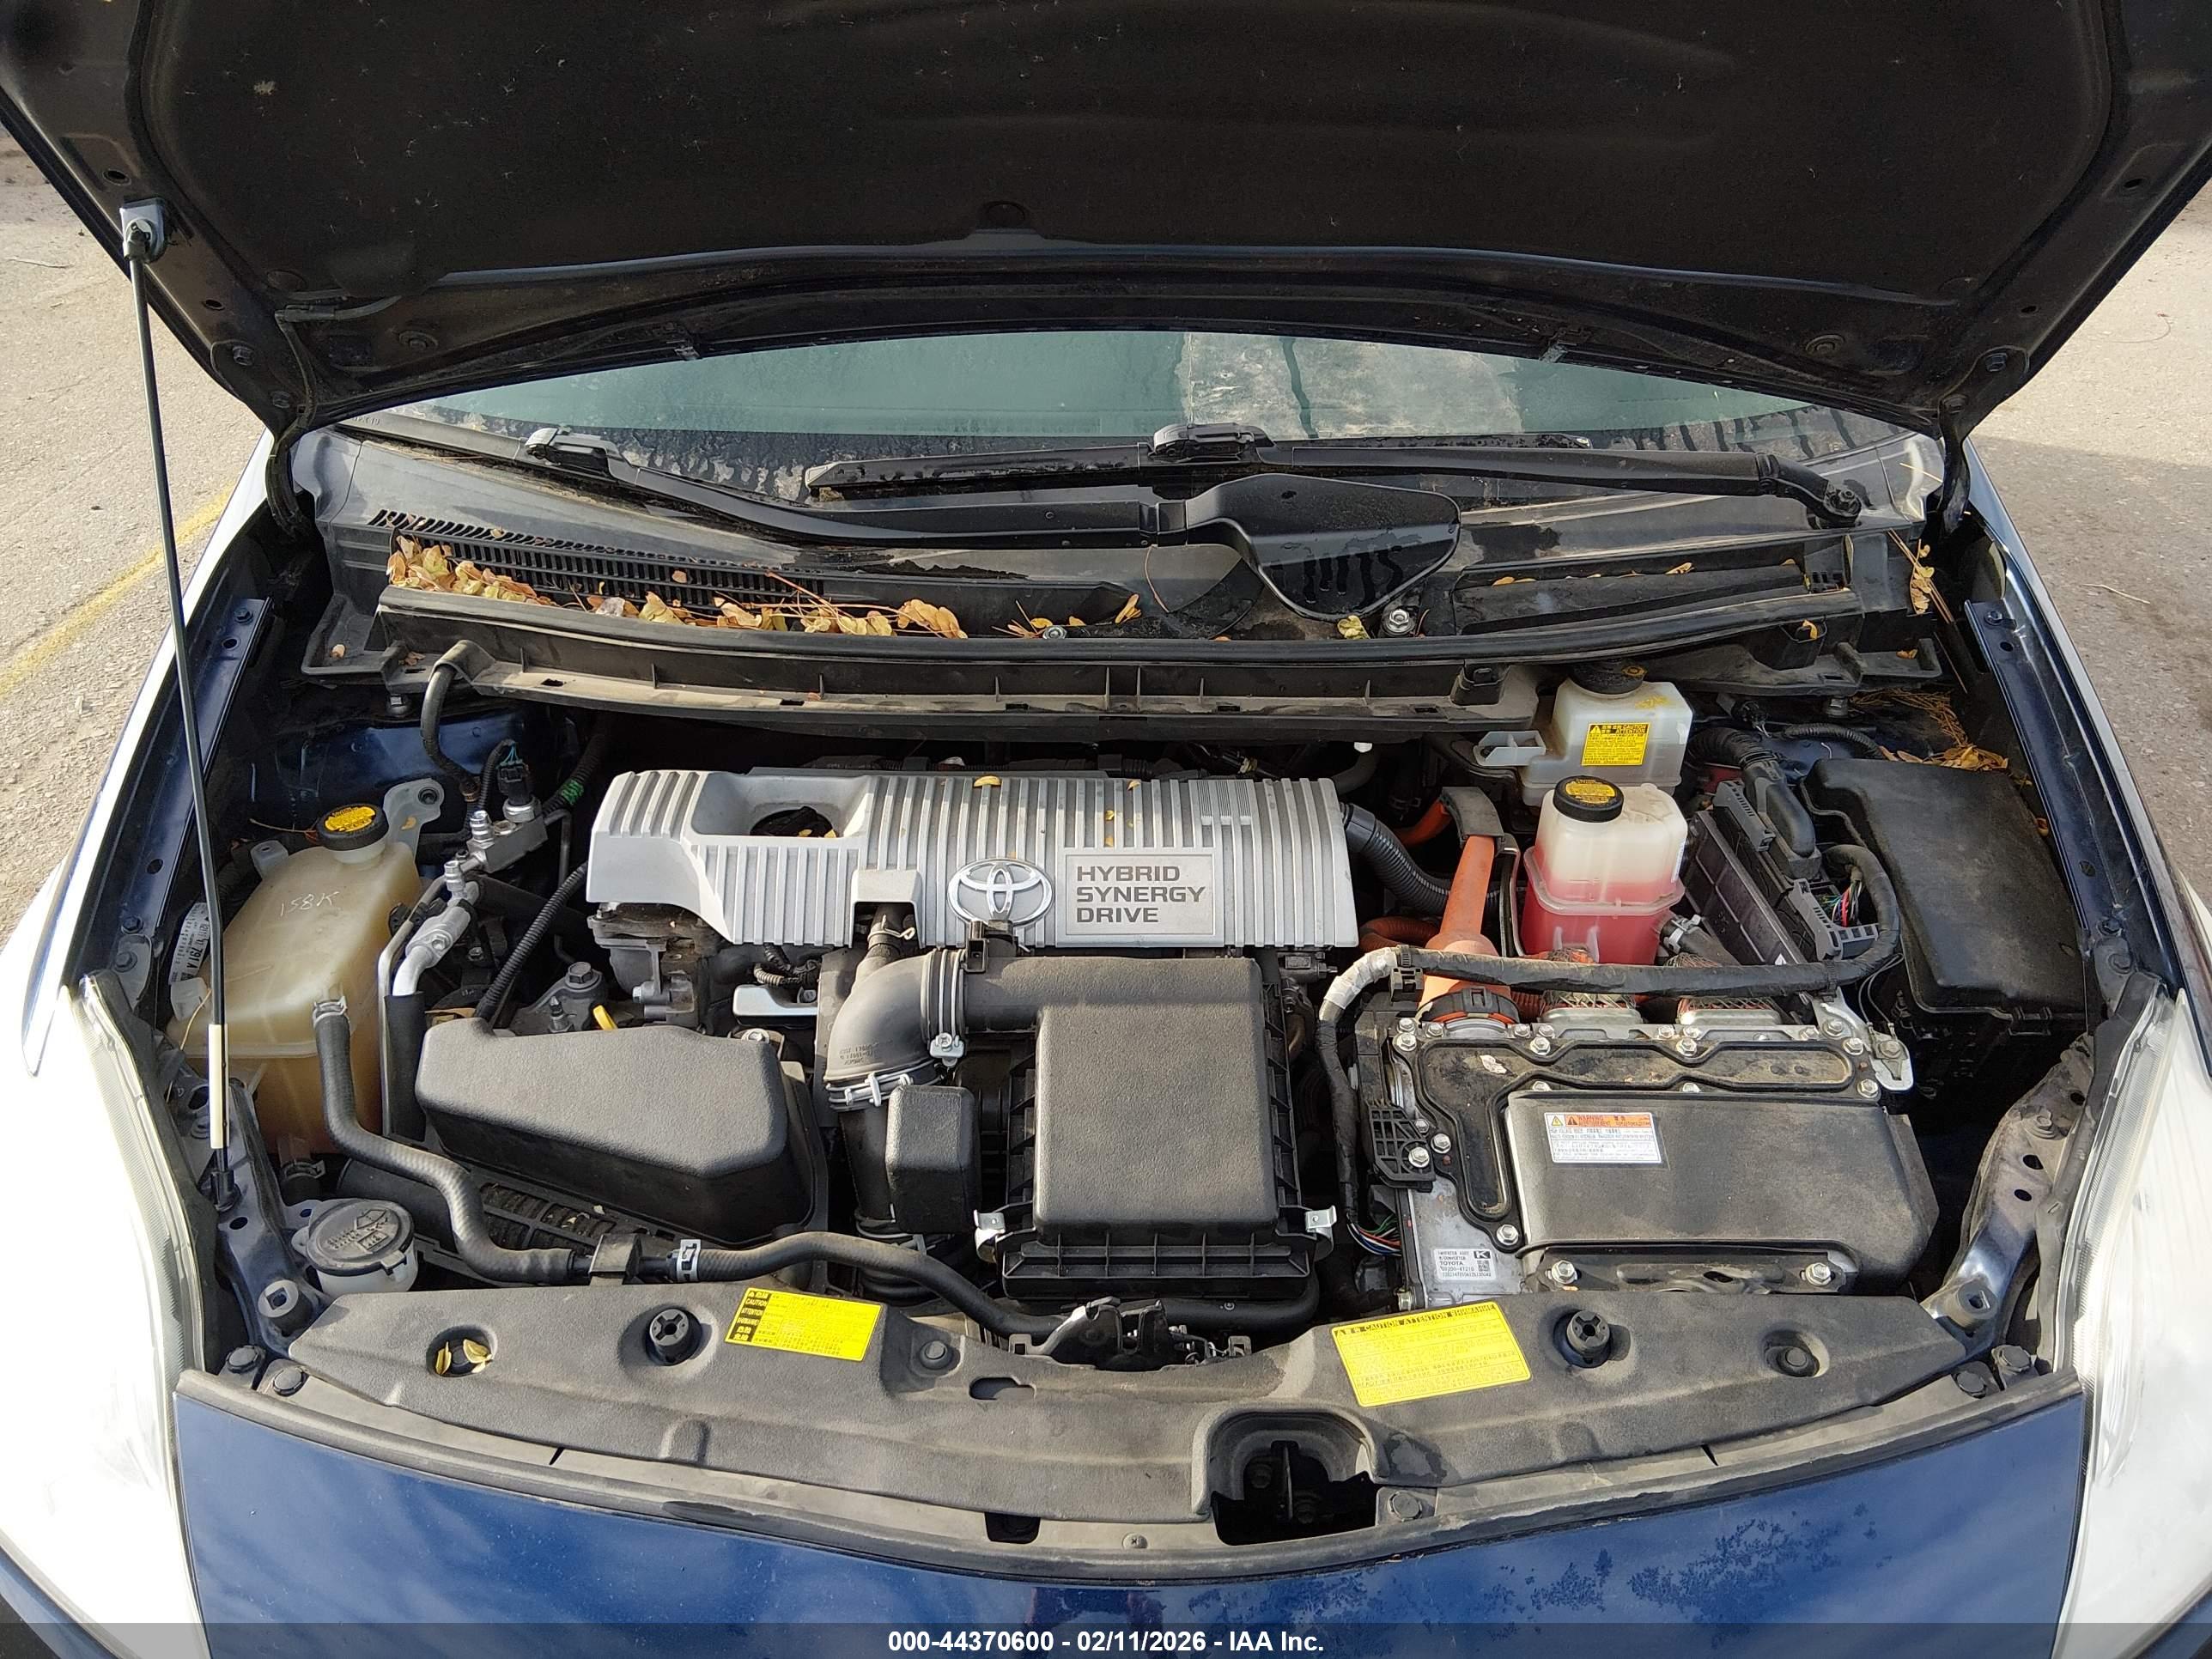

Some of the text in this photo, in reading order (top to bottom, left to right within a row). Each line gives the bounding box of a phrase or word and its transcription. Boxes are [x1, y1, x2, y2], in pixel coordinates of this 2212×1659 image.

[1077, 866, 1180, 882] HYBRID
[1076, 886, 1206, 902] SYNERGY
[1077, 908, 1158, 923] DRIVE
[744, 1298, 767, 1307] CAUTION
[1364, 1320, 1400, 1331] CAUTION
[1403, 1311, 1448, 1325] ATTENTION
